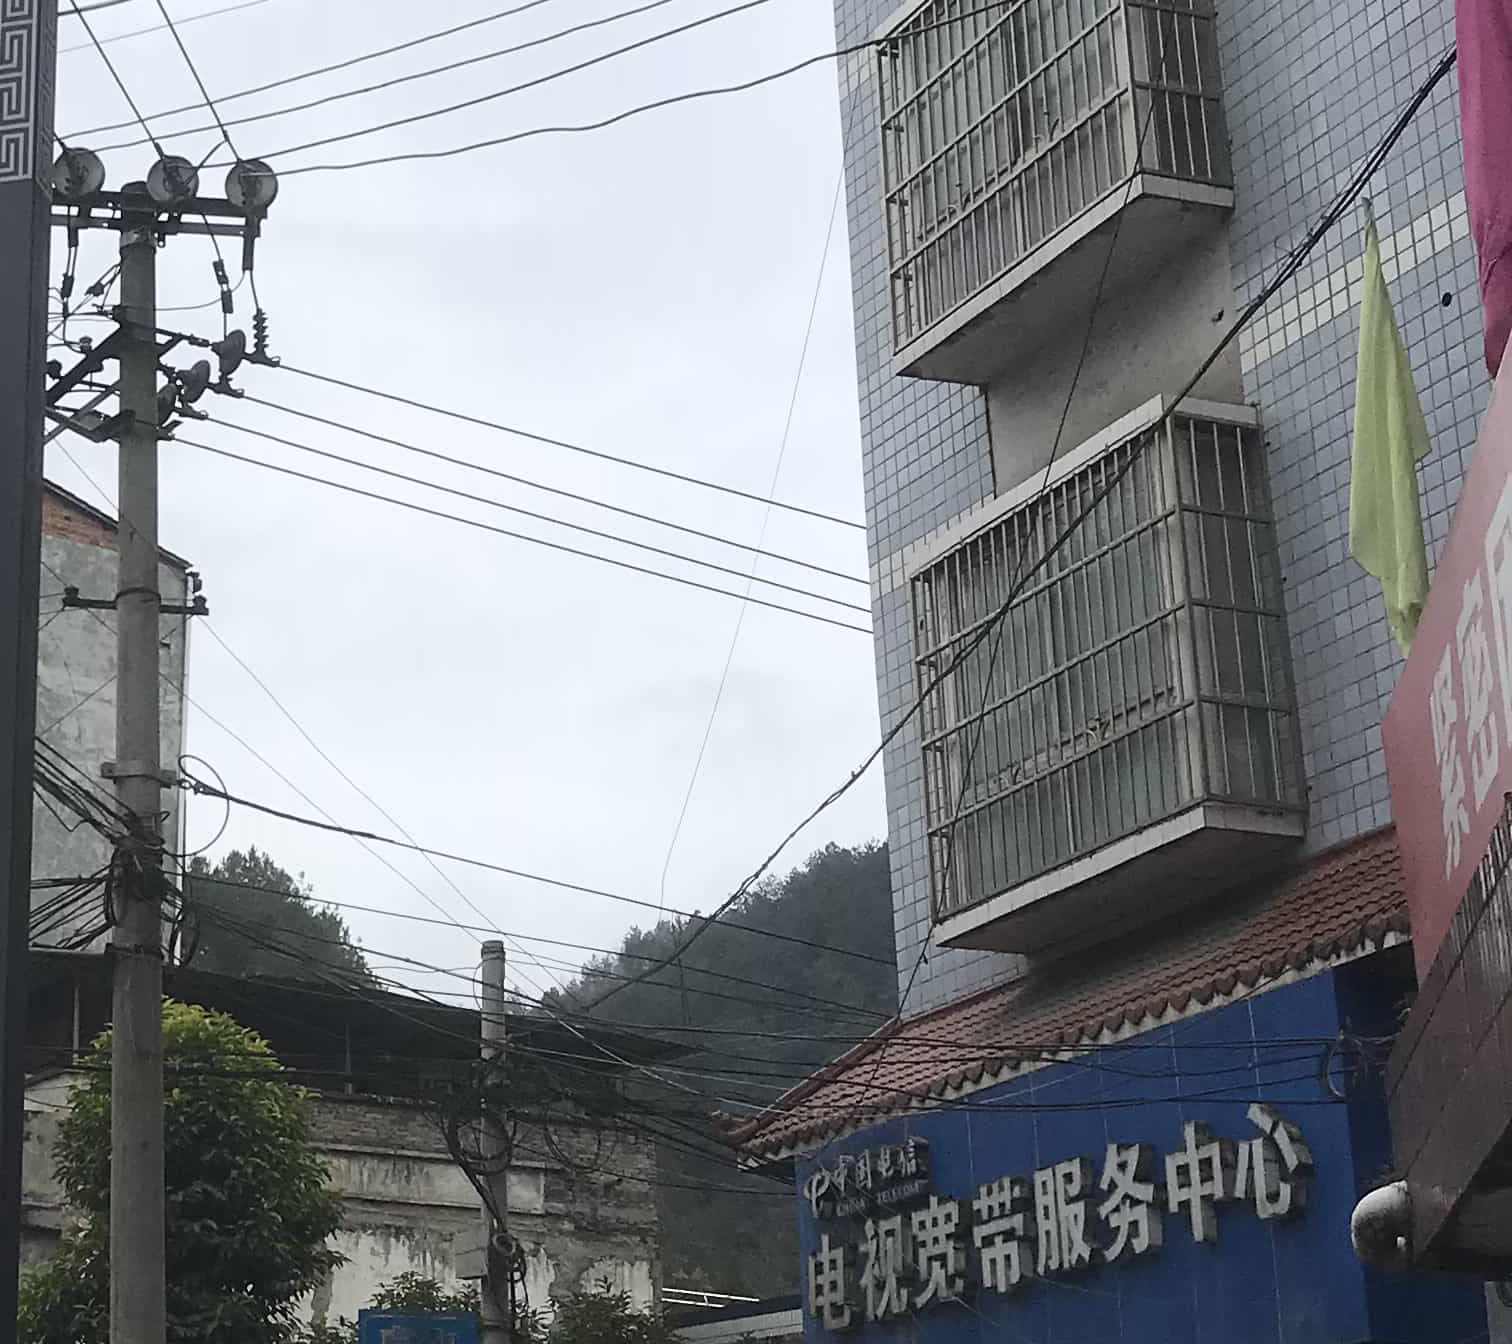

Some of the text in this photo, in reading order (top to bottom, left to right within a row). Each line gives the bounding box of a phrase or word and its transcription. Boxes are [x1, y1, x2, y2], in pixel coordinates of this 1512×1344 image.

[808, 1104, 1310, 1330] 电视宽带服务中心
[832, 1138, 918, 1194] 中国电信
